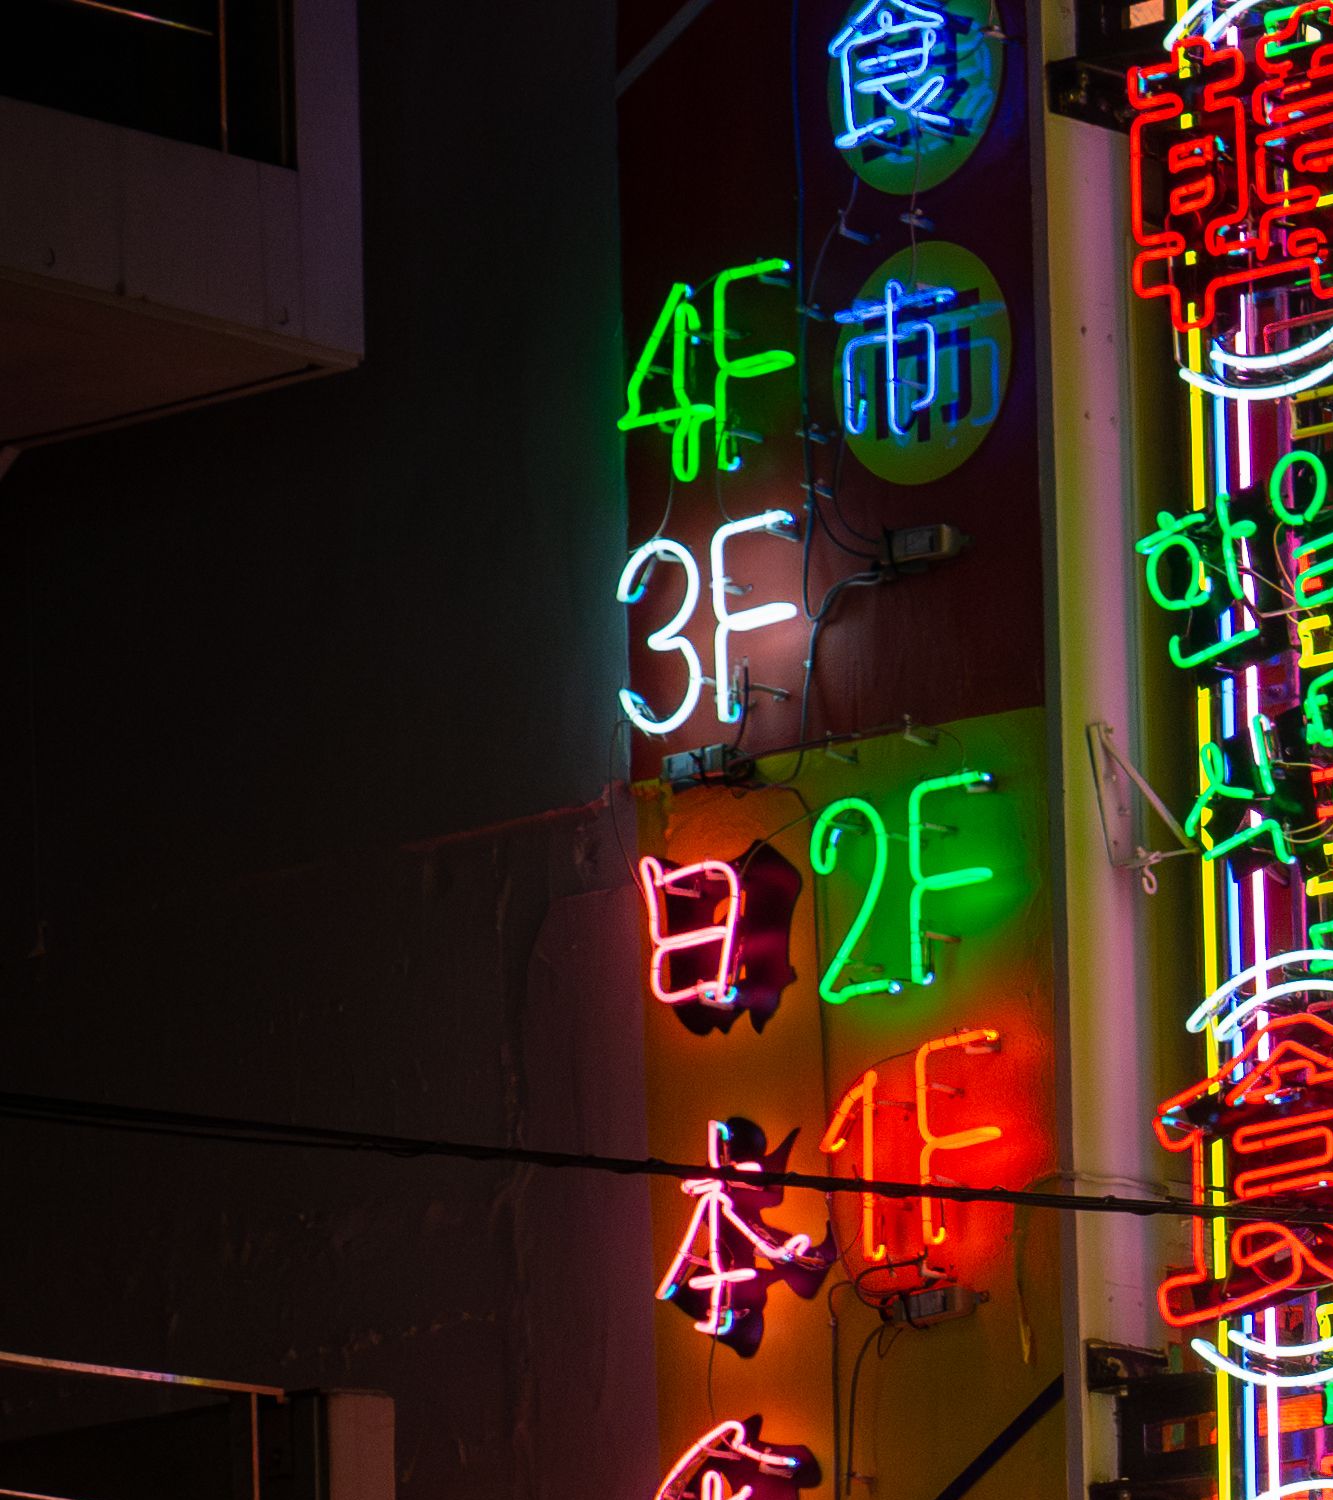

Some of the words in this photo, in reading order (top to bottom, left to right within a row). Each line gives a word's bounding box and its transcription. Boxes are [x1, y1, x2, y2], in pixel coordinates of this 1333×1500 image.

[617, 258, 797, 482] 4F
[617, 510, 798, 735] 3F
[810, 770, 993, 1002] 2F
[819, 1028, 1002, 1262] 1F
